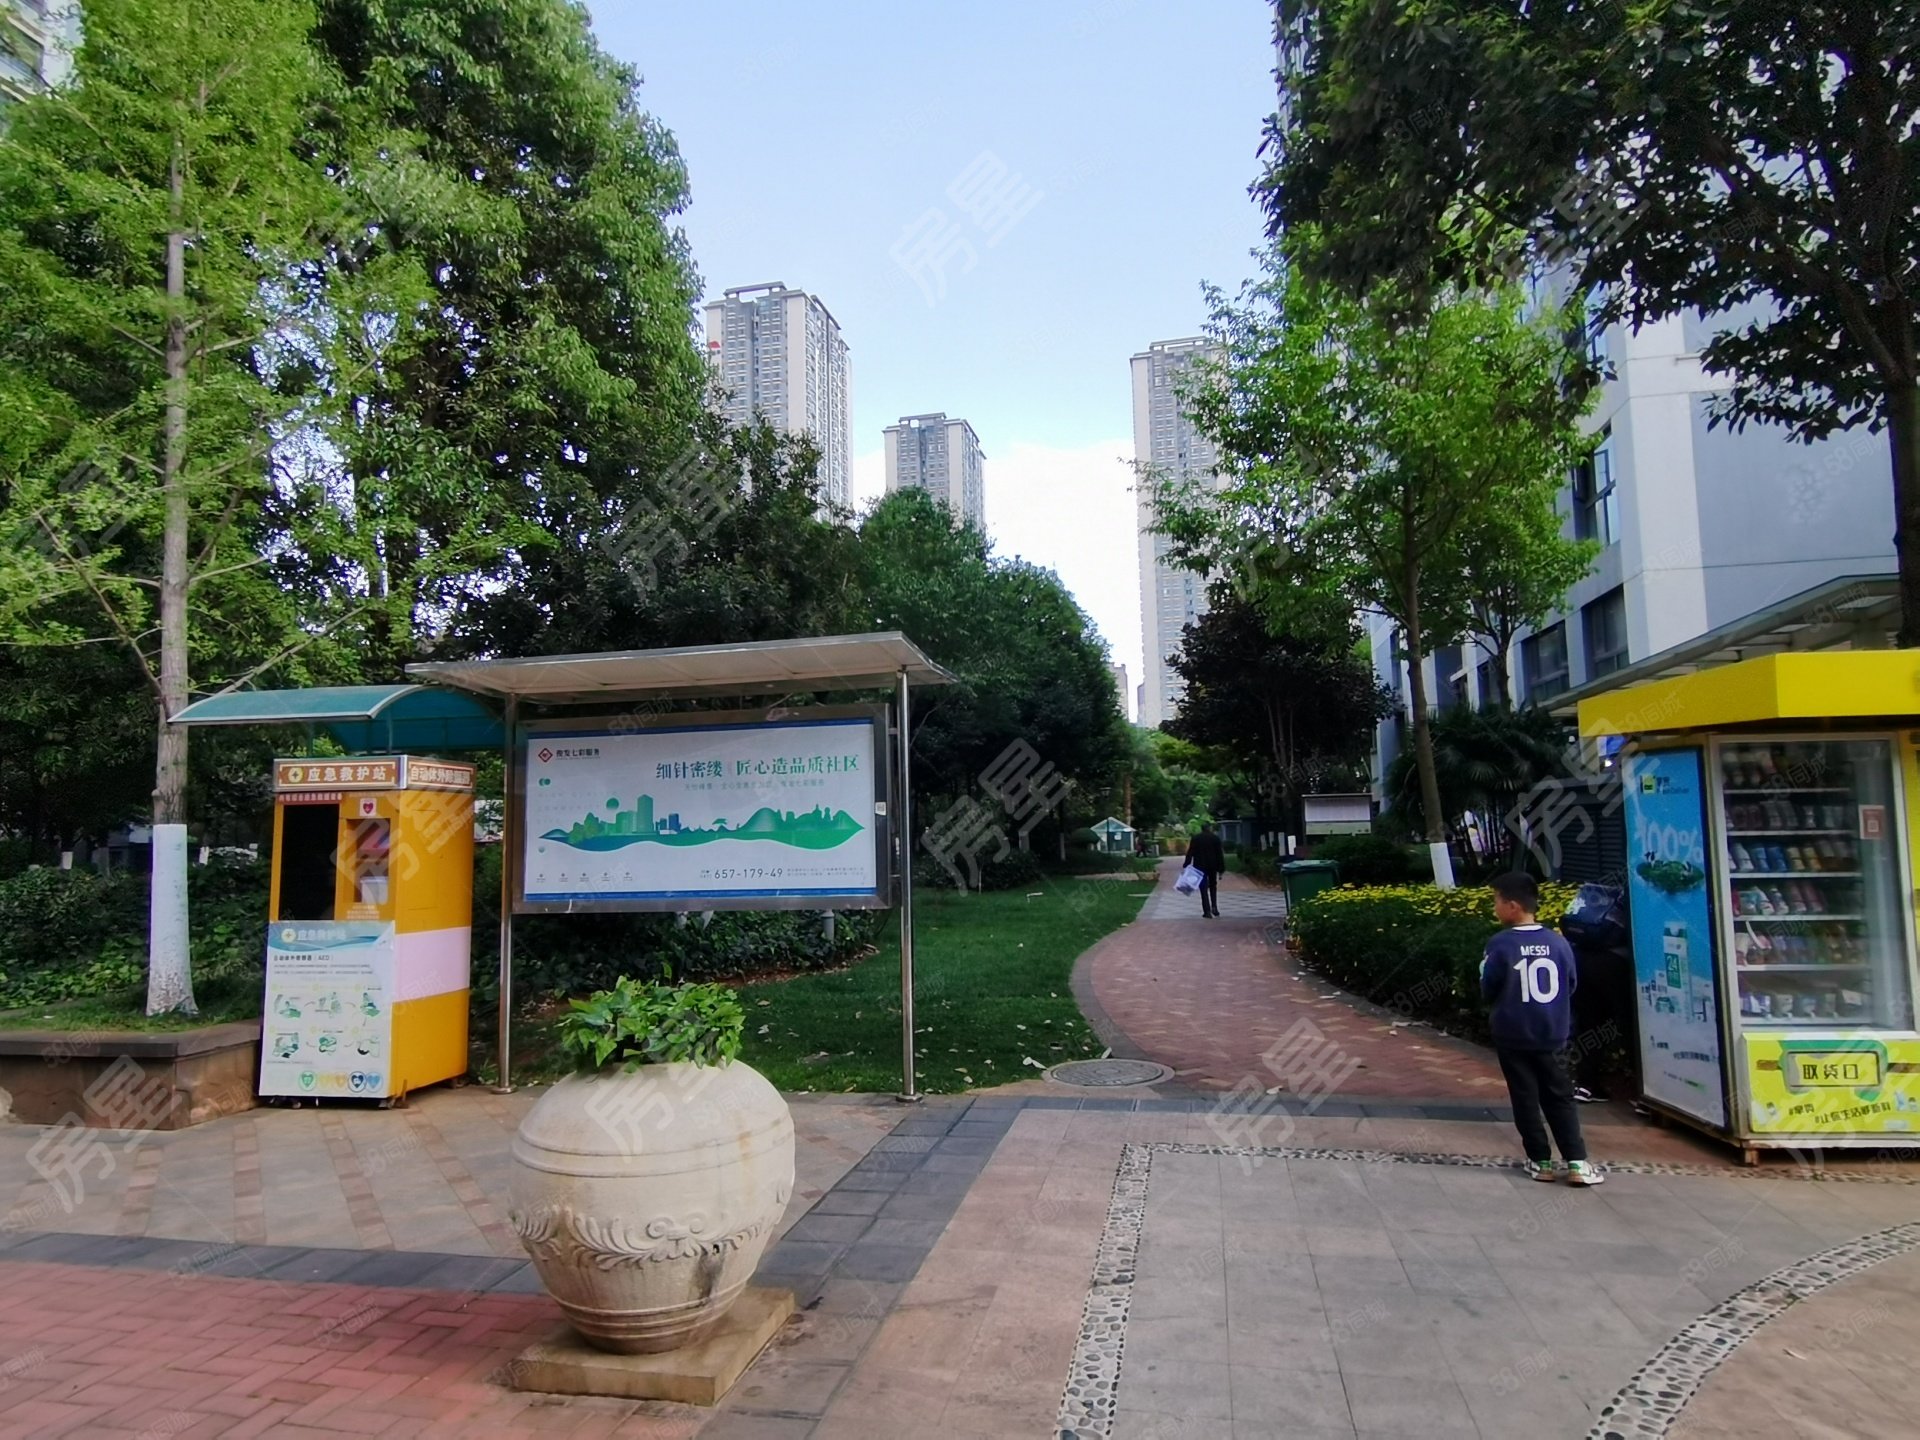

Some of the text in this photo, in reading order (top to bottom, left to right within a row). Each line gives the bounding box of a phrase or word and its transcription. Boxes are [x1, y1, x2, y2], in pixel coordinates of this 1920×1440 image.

[307, 766, 386, 782] 应急救护站
[656, 754, 859, 780] 细针密缕 匠心造品质社区
[714, 868, 783, 879] 657-179-49
[1520, 945, 1550, 956] MESSI
[1513, 958, 1560, 1004] 10
[1802, 1064, 1859, 1080] 取货口
